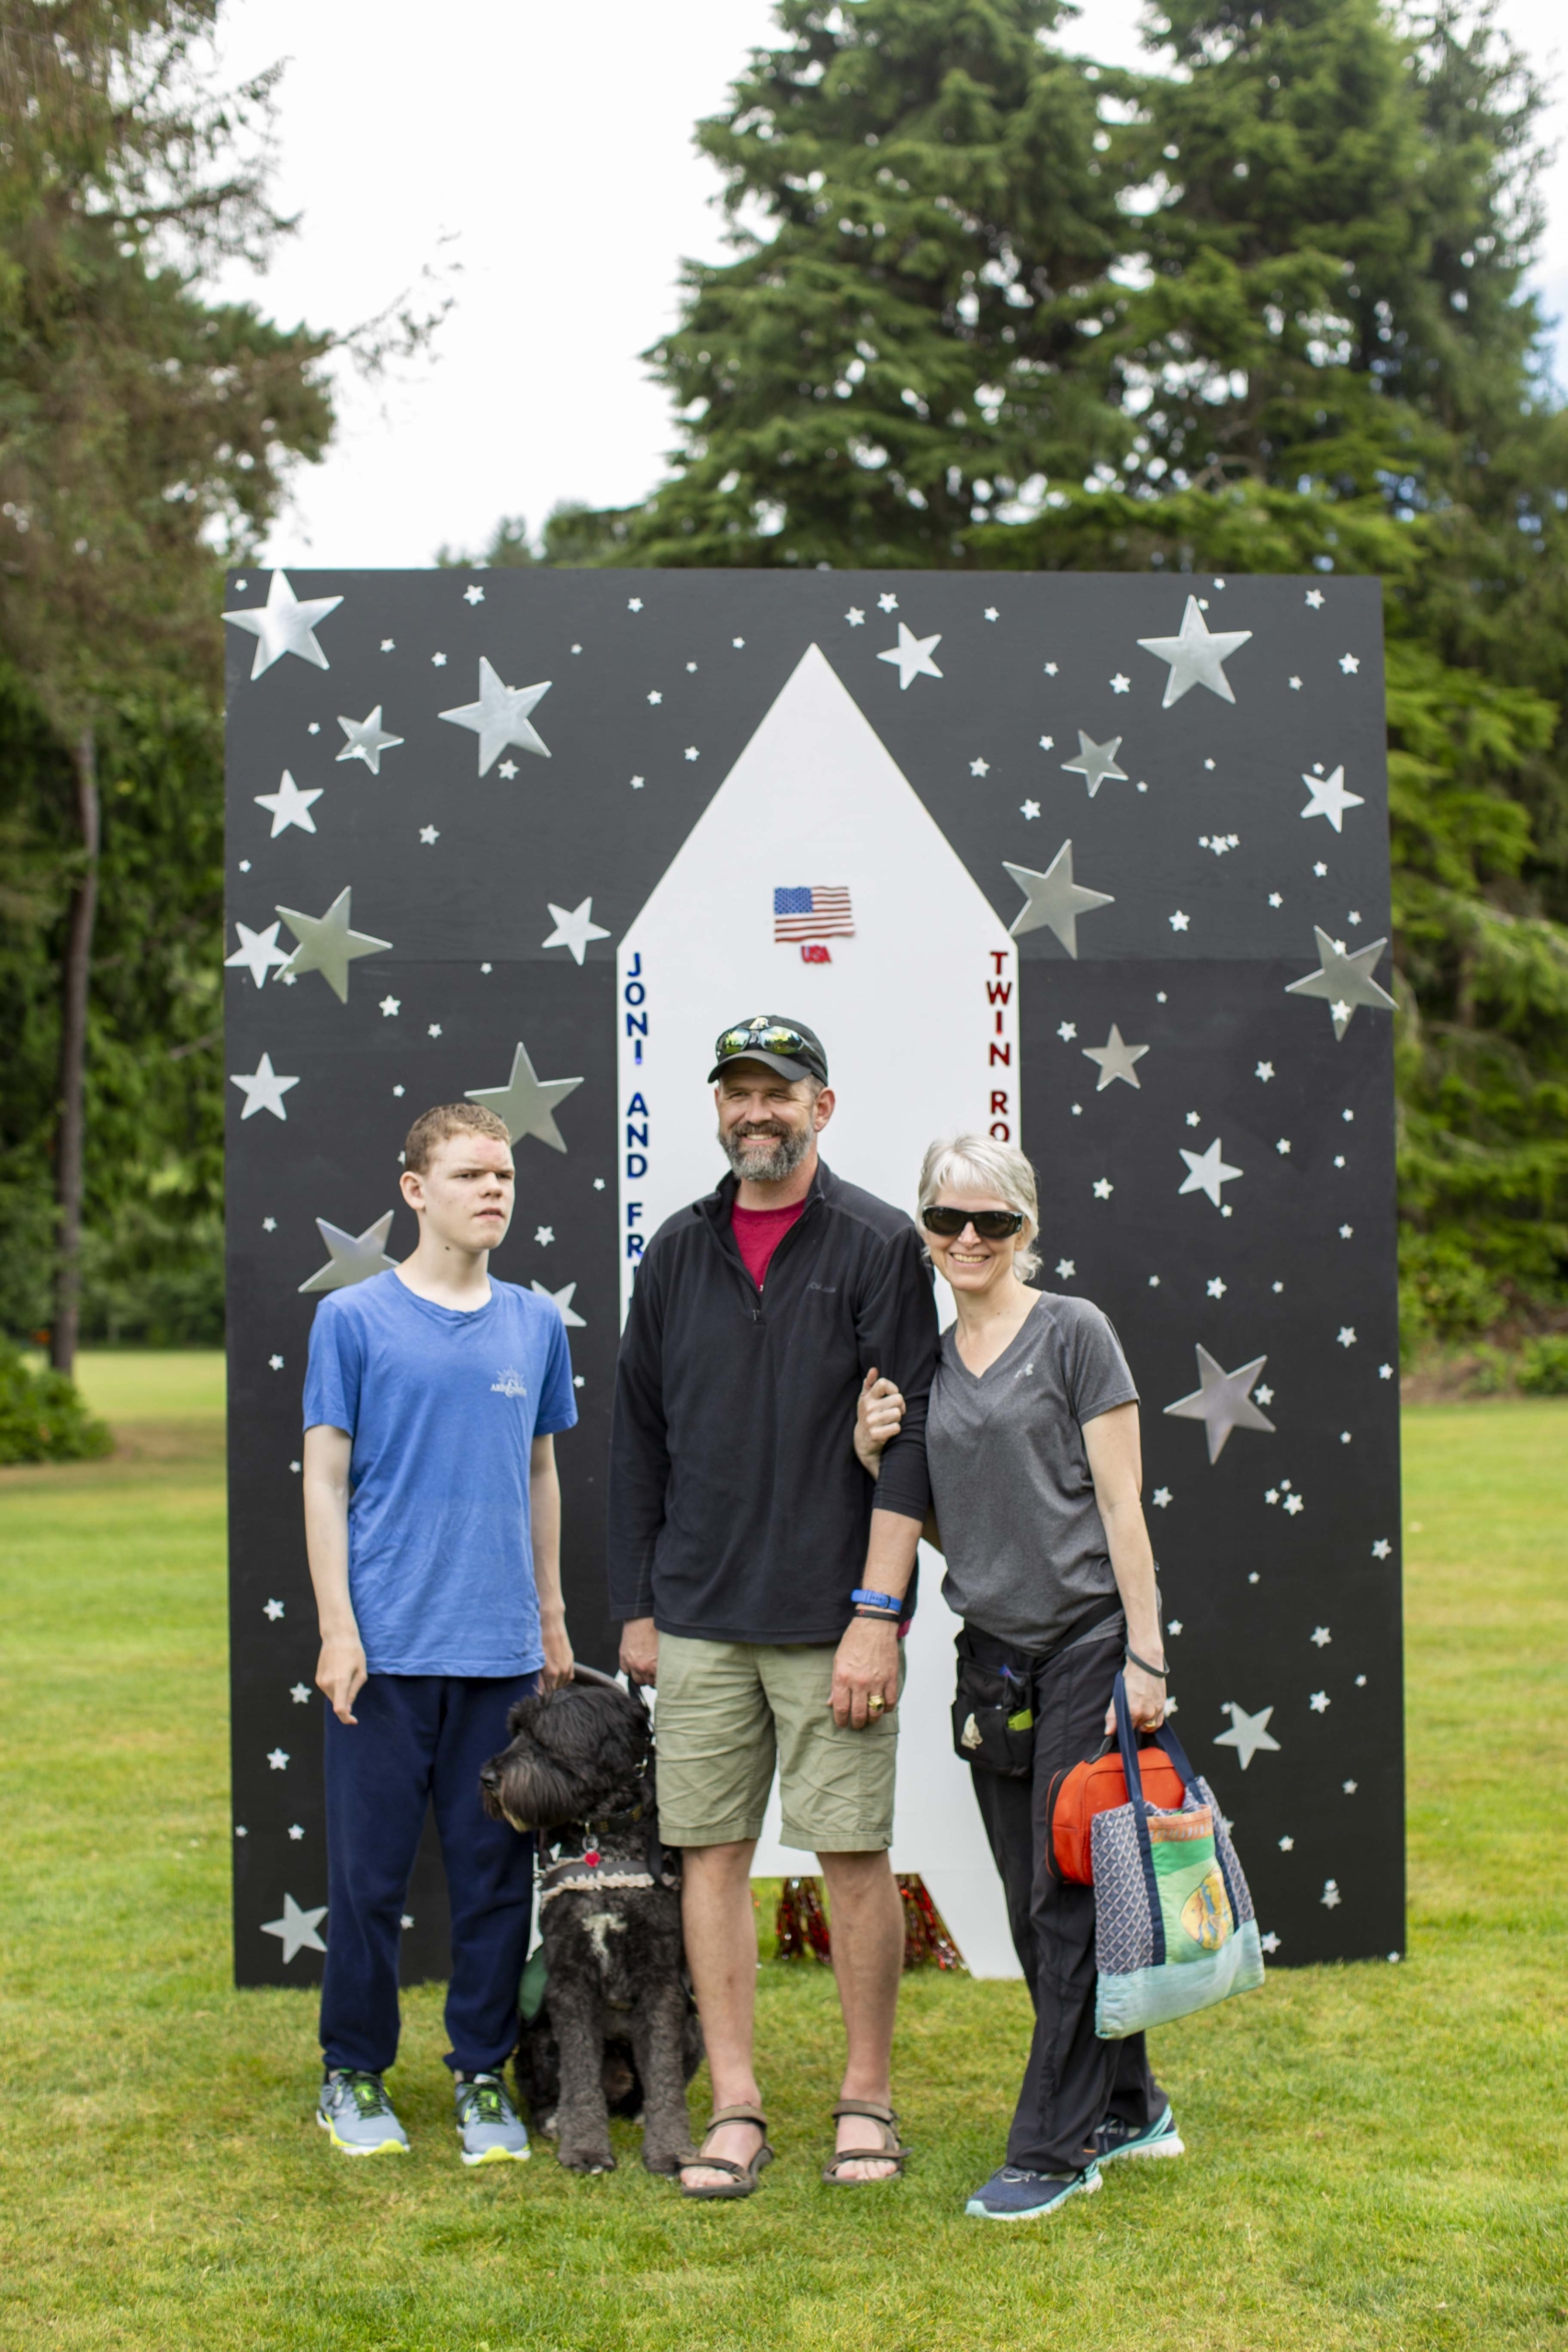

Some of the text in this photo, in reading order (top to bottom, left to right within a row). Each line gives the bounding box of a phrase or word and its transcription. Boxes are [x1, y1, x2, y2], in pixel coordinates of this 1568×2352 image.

[625, 952, 649, 1065] JONI
[986, 951, 1012, 1143] TWIN RO
[626, 1092, 649, 1180] AND
